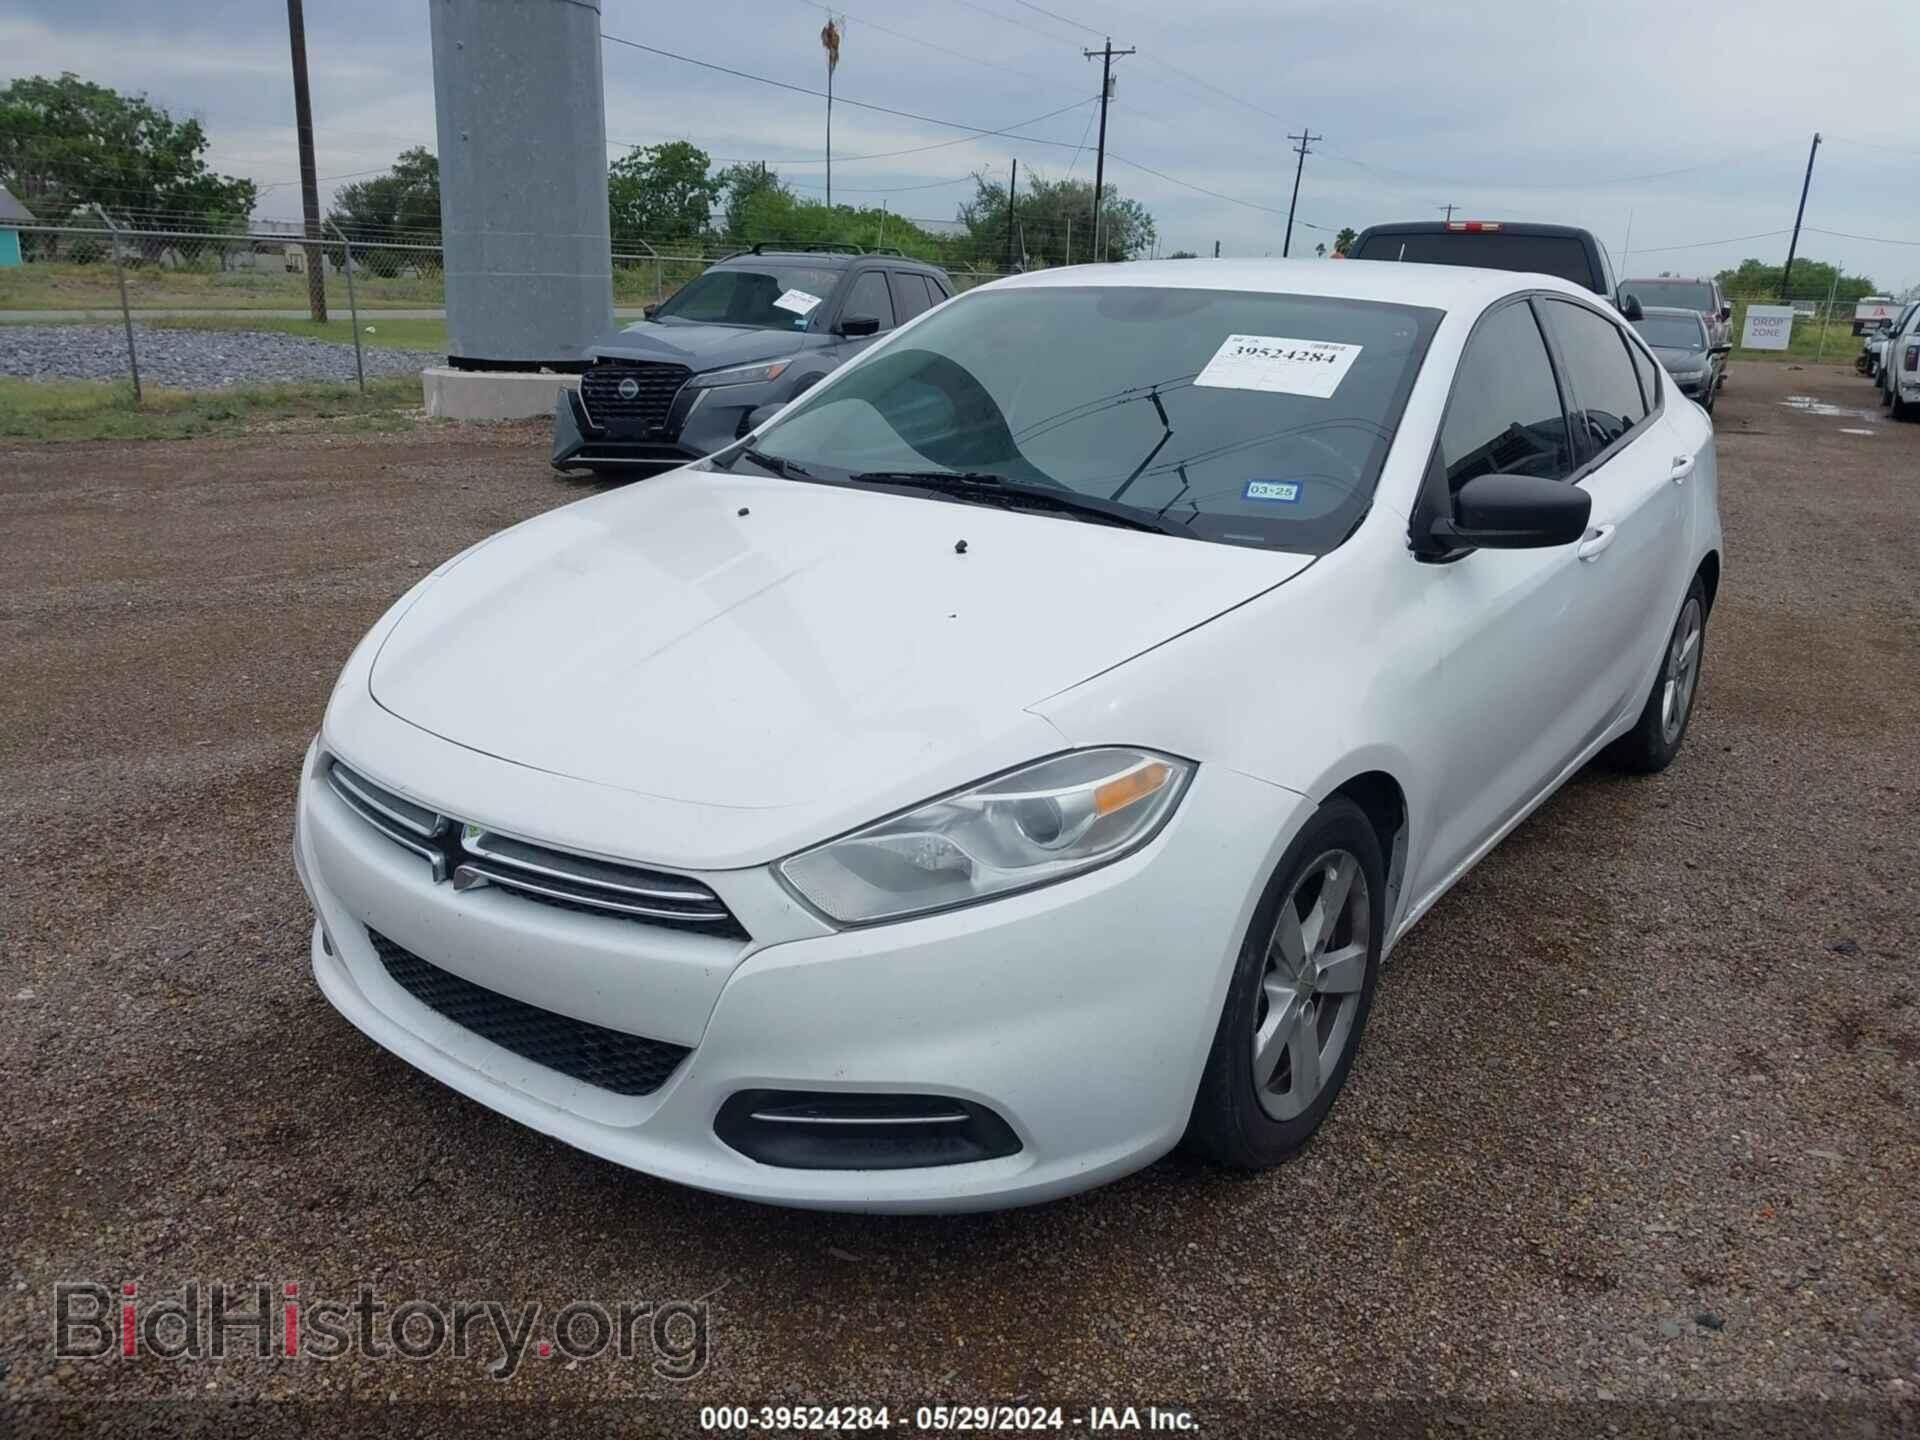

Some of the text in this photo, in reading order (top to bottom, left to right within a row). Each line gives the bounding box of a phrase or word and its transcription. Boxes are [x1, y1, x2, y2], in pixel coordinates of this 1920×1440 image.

[1752, 319, 1784, 327] DROP
[1751, 328, 1780, 337] ZONE
[1231, 345, 1336, 364] 39524284
[1250, 486, 1293, 497] 03-25
